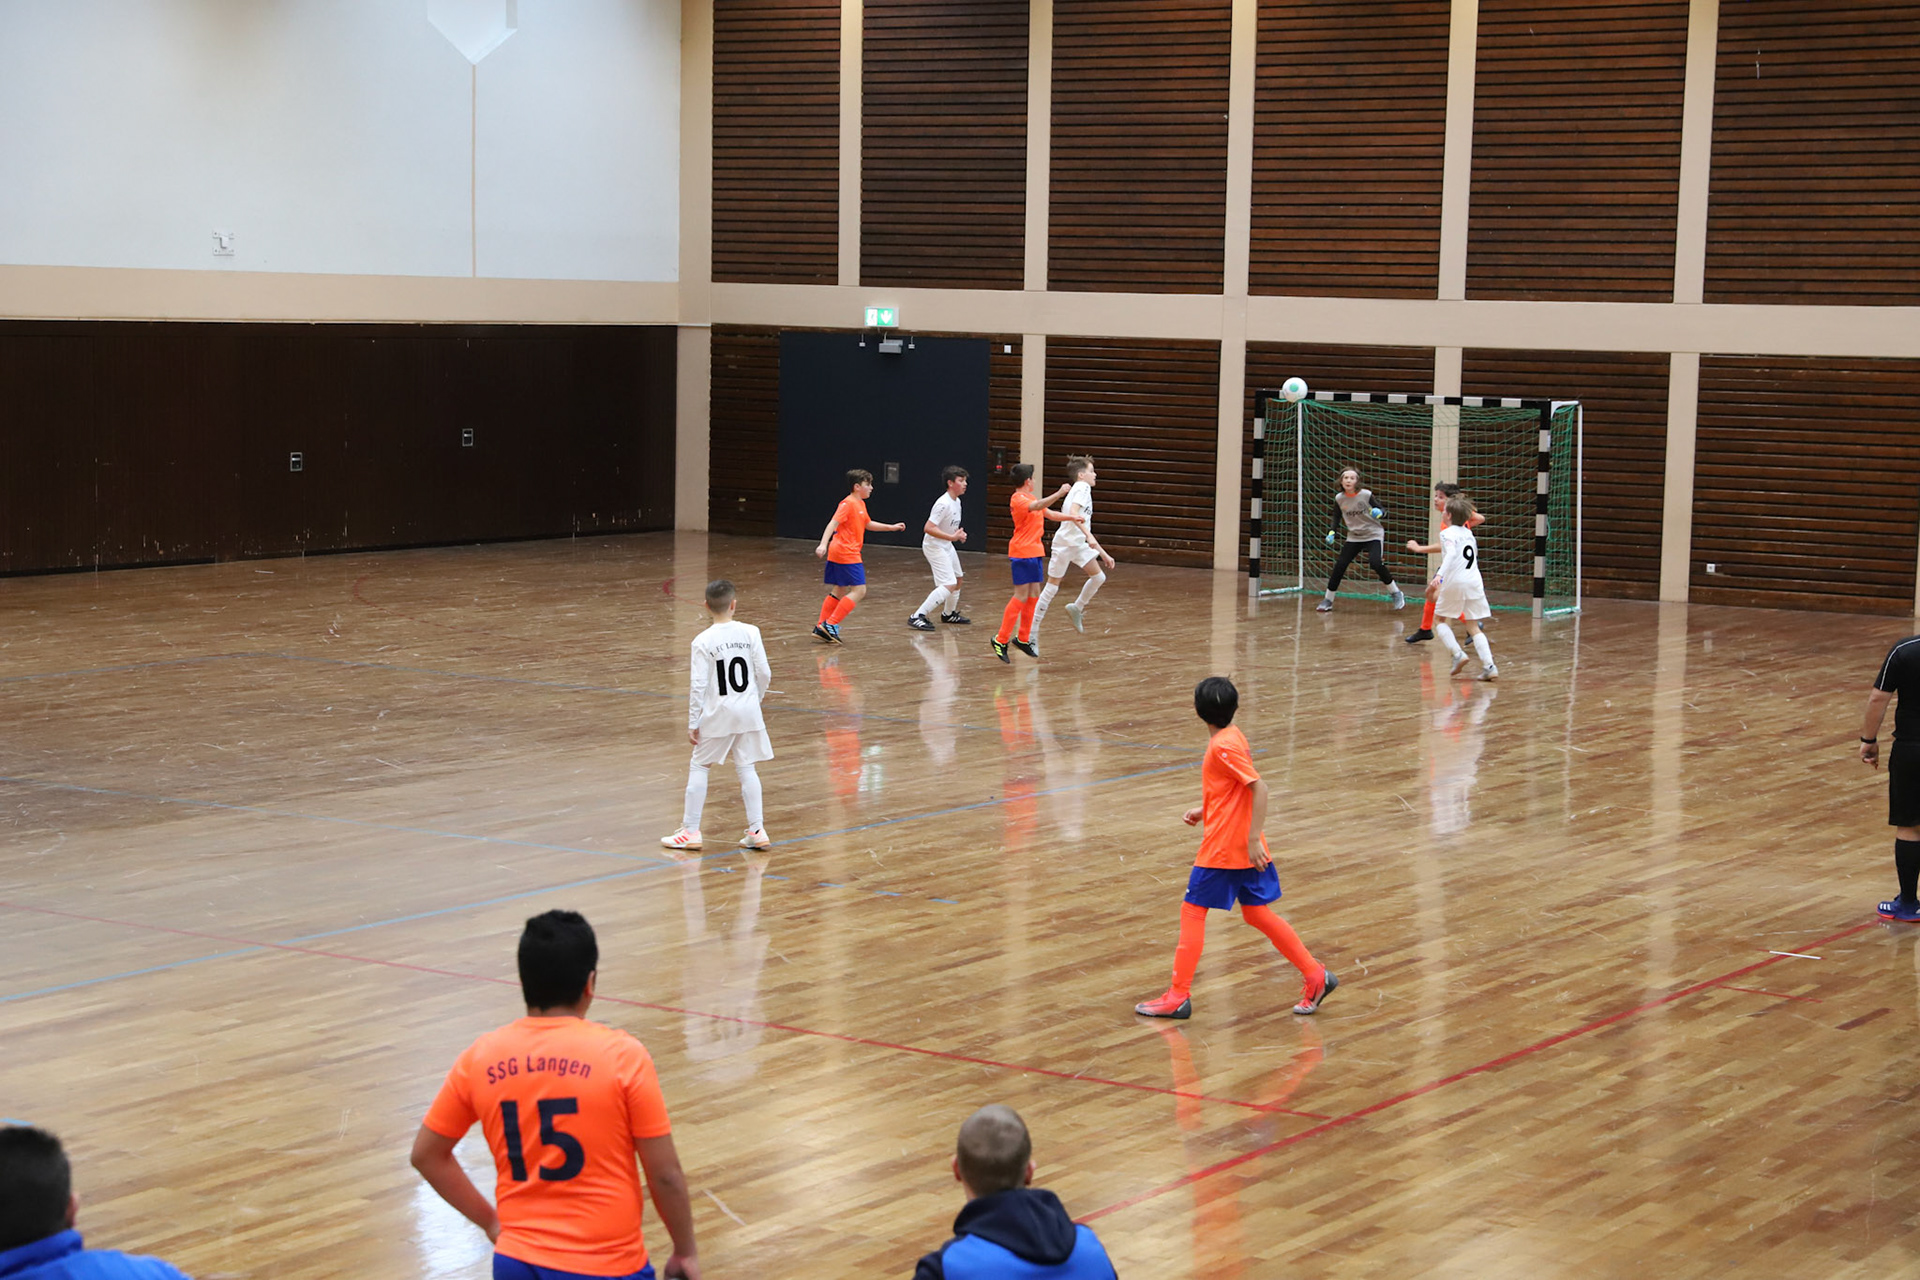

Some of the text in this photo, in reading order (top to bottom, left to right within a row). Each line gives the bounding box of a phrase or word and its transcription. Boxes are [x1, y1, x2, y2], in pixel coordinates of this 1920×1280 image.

[1463, 545, 1474, 569] 9
[725, 642, 751, 650] Langen
[716, 656, 749, 696] 10
[487, 1055, 591, 1084] SSG Langen
[500, 1097, 585, 1182] 15
